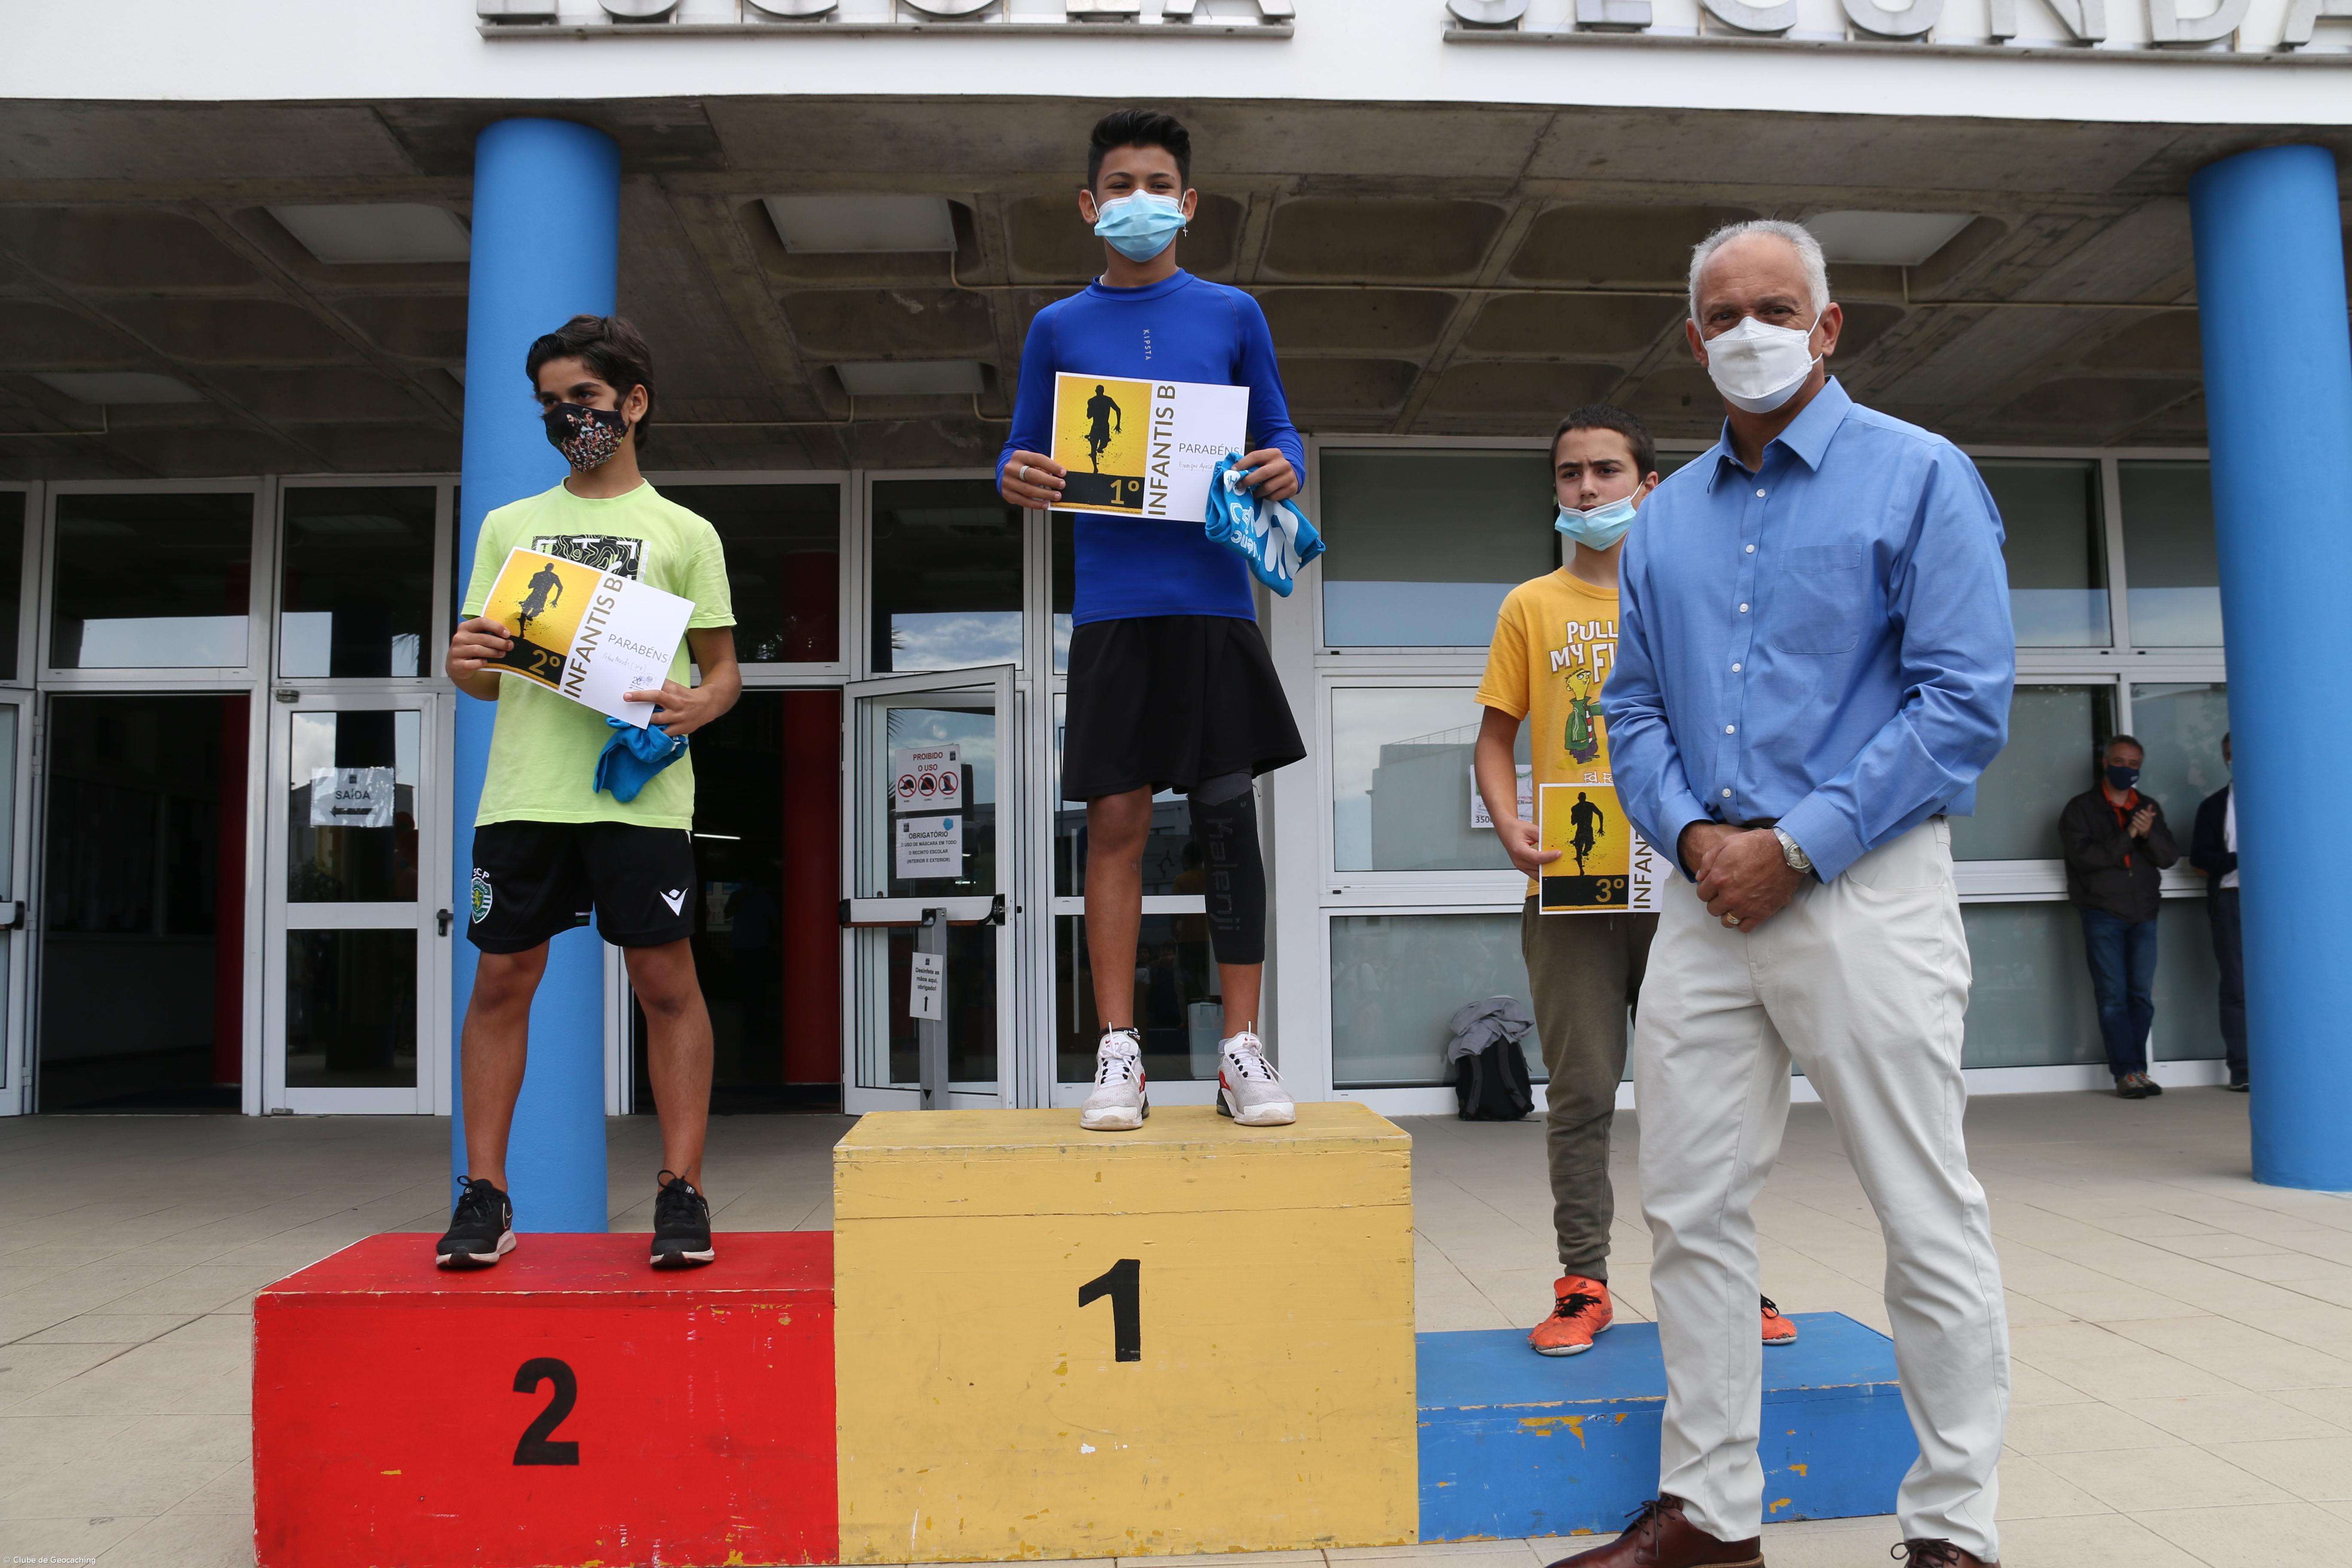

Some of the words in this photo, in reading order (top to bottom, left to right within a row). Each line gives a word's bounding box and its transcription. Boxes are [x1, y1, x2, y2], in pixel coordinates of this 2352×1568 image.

[1142, 329, 1152, 360] KIPSTA
[1157, 384, 1176, 400] B
[1148, 407, 1174, 516] INFANTIS
[564, 594, 615, 698] INFANTIS
[603, 577, 623, 593] B
[1566, 620, 1619, 644] PULL
[608, 634, 671, 665] PARABÉNS!
[1549, 643, 1585, 673] MY
[1592, 643, 1617, 684] FI
[913, 751, 943, 760] PROIBIDO
[335, 788, 371, 799] SAÍDA
[908, 830, 949, 839] OBRIGATÓRIO
[473, 868, 490, 879] SCP
[1078, 1258, 1142, 1363] 1
[511, 1356, 580, 1467] 2
